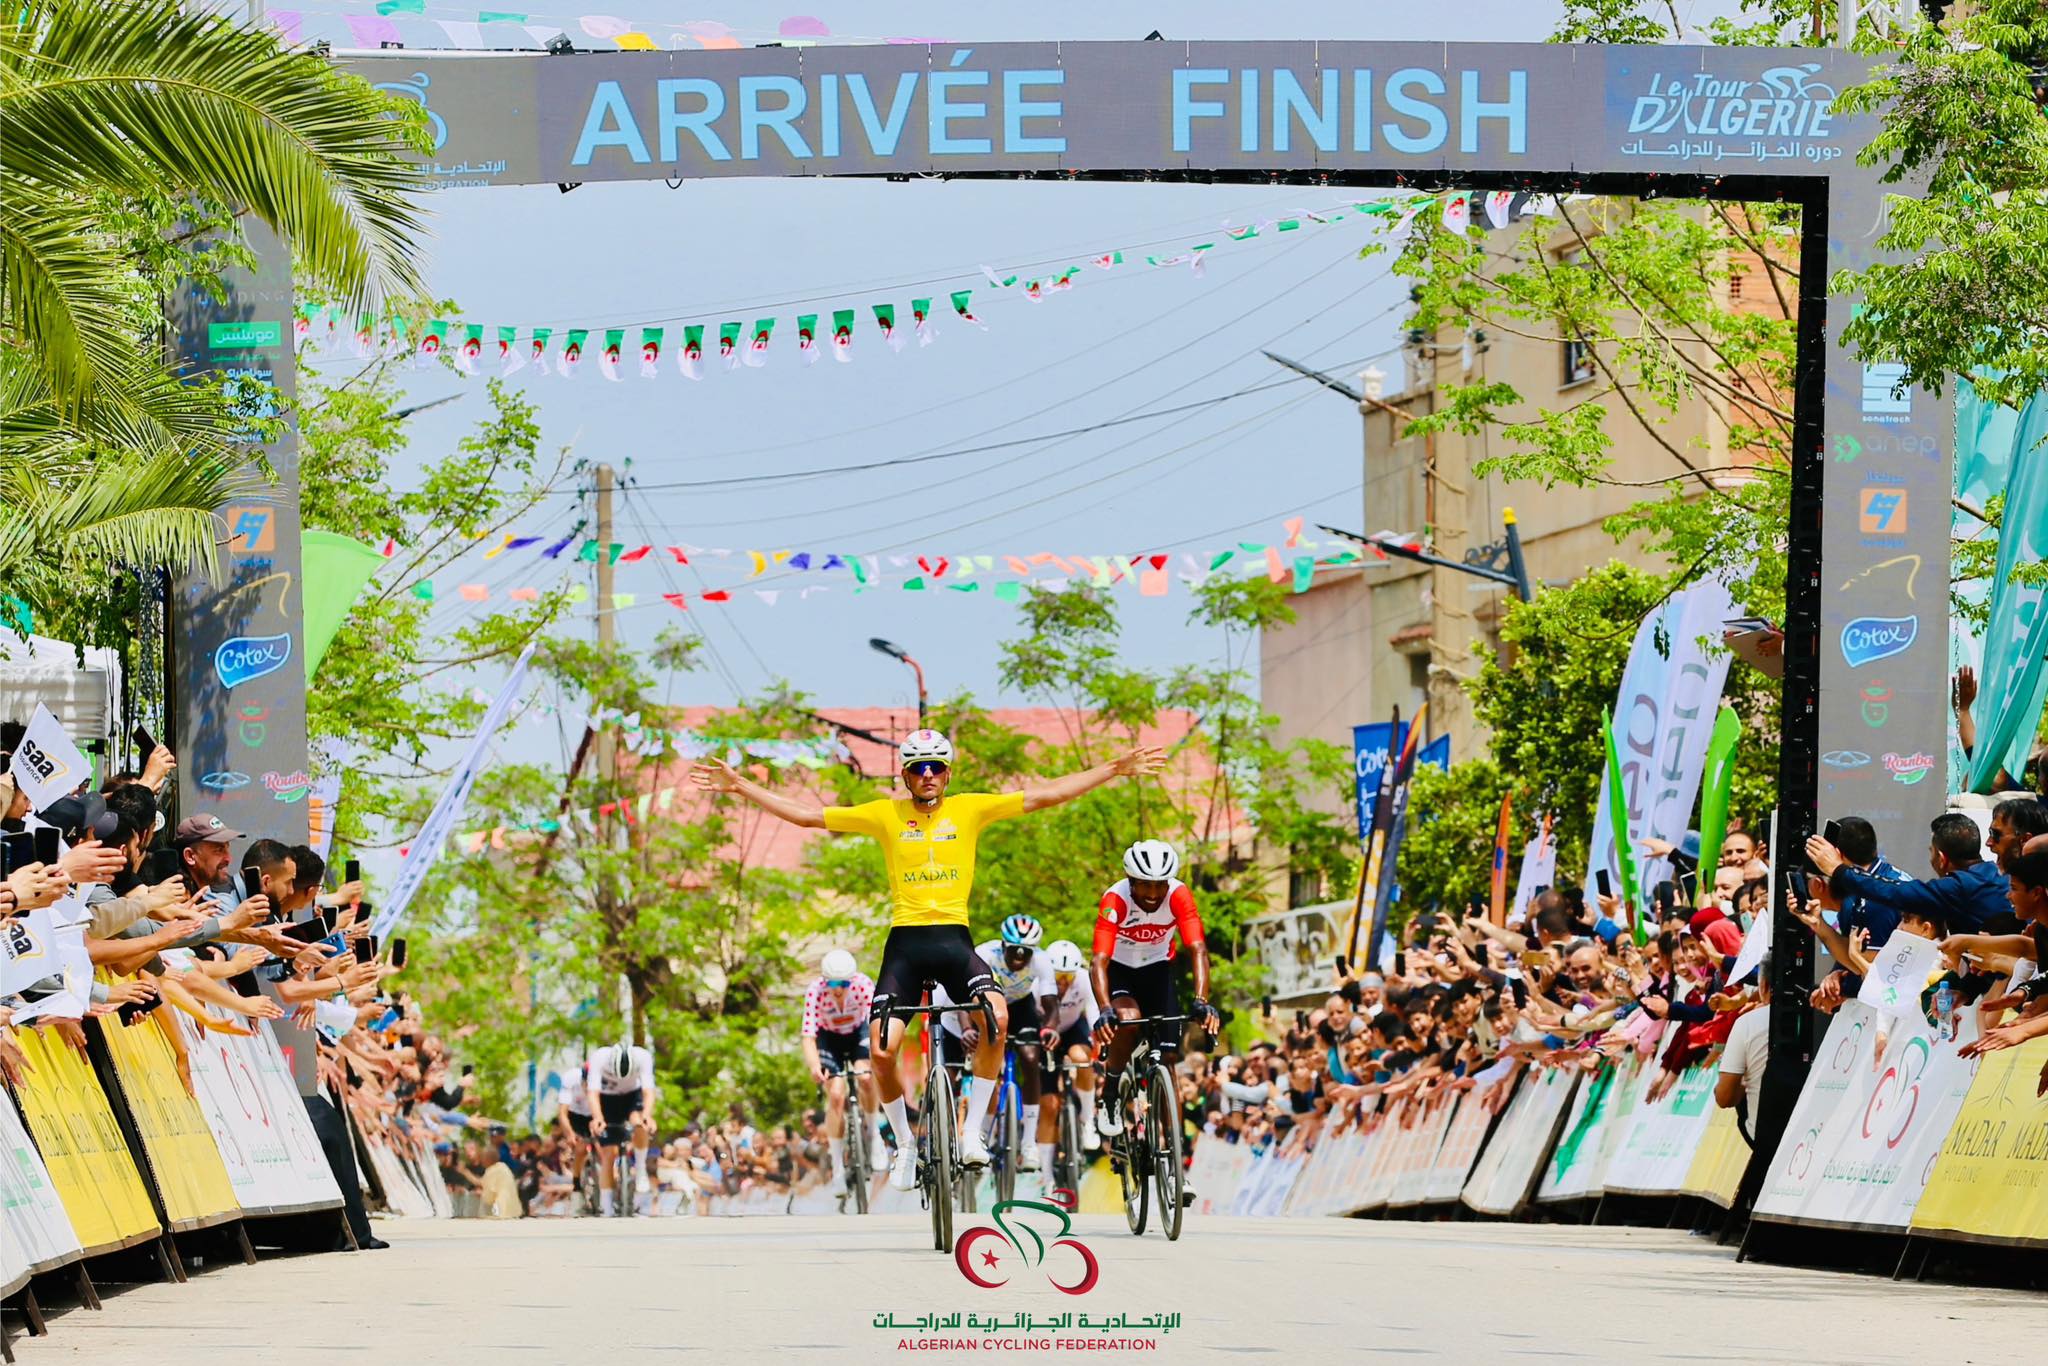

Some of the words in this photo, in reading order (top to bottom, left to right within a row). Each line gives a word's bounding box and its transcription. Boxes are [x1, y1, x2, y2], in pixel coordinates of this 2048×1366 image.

[1649, 73, 1682, 96] Le
[1693, 74, 1752, 97] Tour
[571, 49, 1067, 166] ARRIVÉE
[1171, 68, 1527, 154] FINISH
[1620, 139, 1713, 160] للدراجات
[1714, 141, 1800, 162] الجزائر
[1804, 145, 1842, 162] دورة
[1862, 414, 1911, 423] sonatrach
[1866, 434, 1937, 453] anep
[1846, 624, 1908, 651] Cotex
[220, 643, 281, 672] Cotex
[22, 739, 55, 779] saa
[904, 869, 960, 883] MADAR
[10, 923, 33, 955] aa
[1886, 944, 1914, 985] anep
[1945, 1119, 2007, 1158] MADAR
